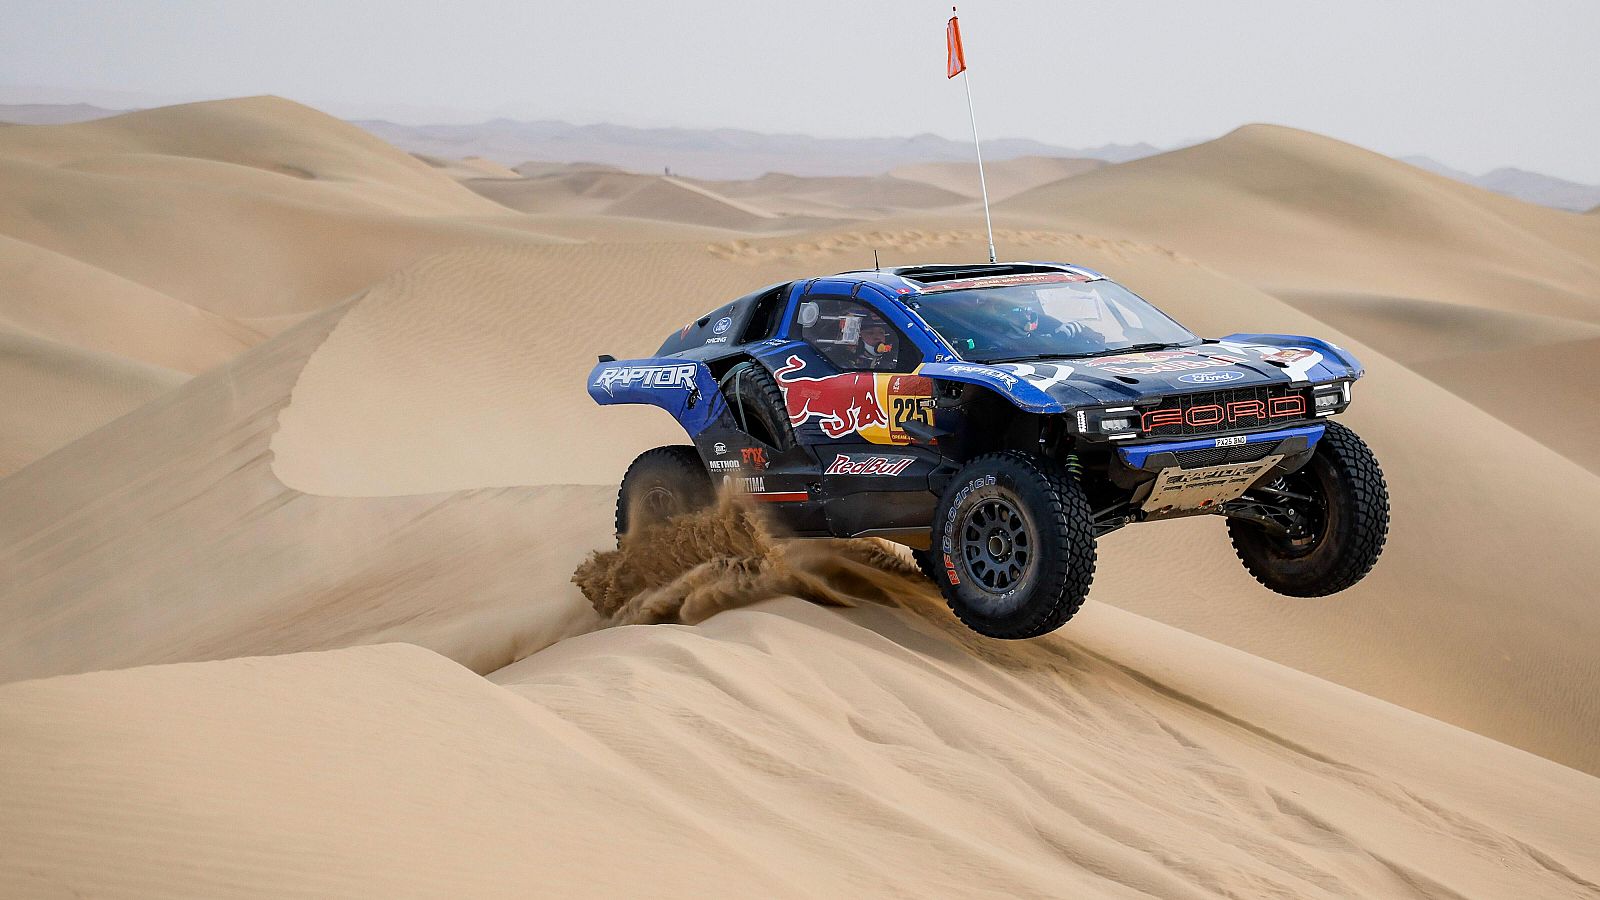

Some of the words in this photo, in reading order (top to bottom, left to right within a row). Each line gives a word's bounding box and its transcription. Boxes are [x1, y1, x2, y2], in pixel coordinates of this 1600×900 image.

[705, 336, 727, 344] RACING
[593, 363, 702, 400] RAPTOR
[944, 365, 1018, 391] RAPTOR
[1192, 371, 1233, 383] Ford
[893, 398, 929, 428] 225
[1141, 395, 1306, 432] FORD
[709, 460, 740, 468] METHOD
[741, 447, 765, 463] FOX
[942, 474, 997, 586] BFGoodrich
